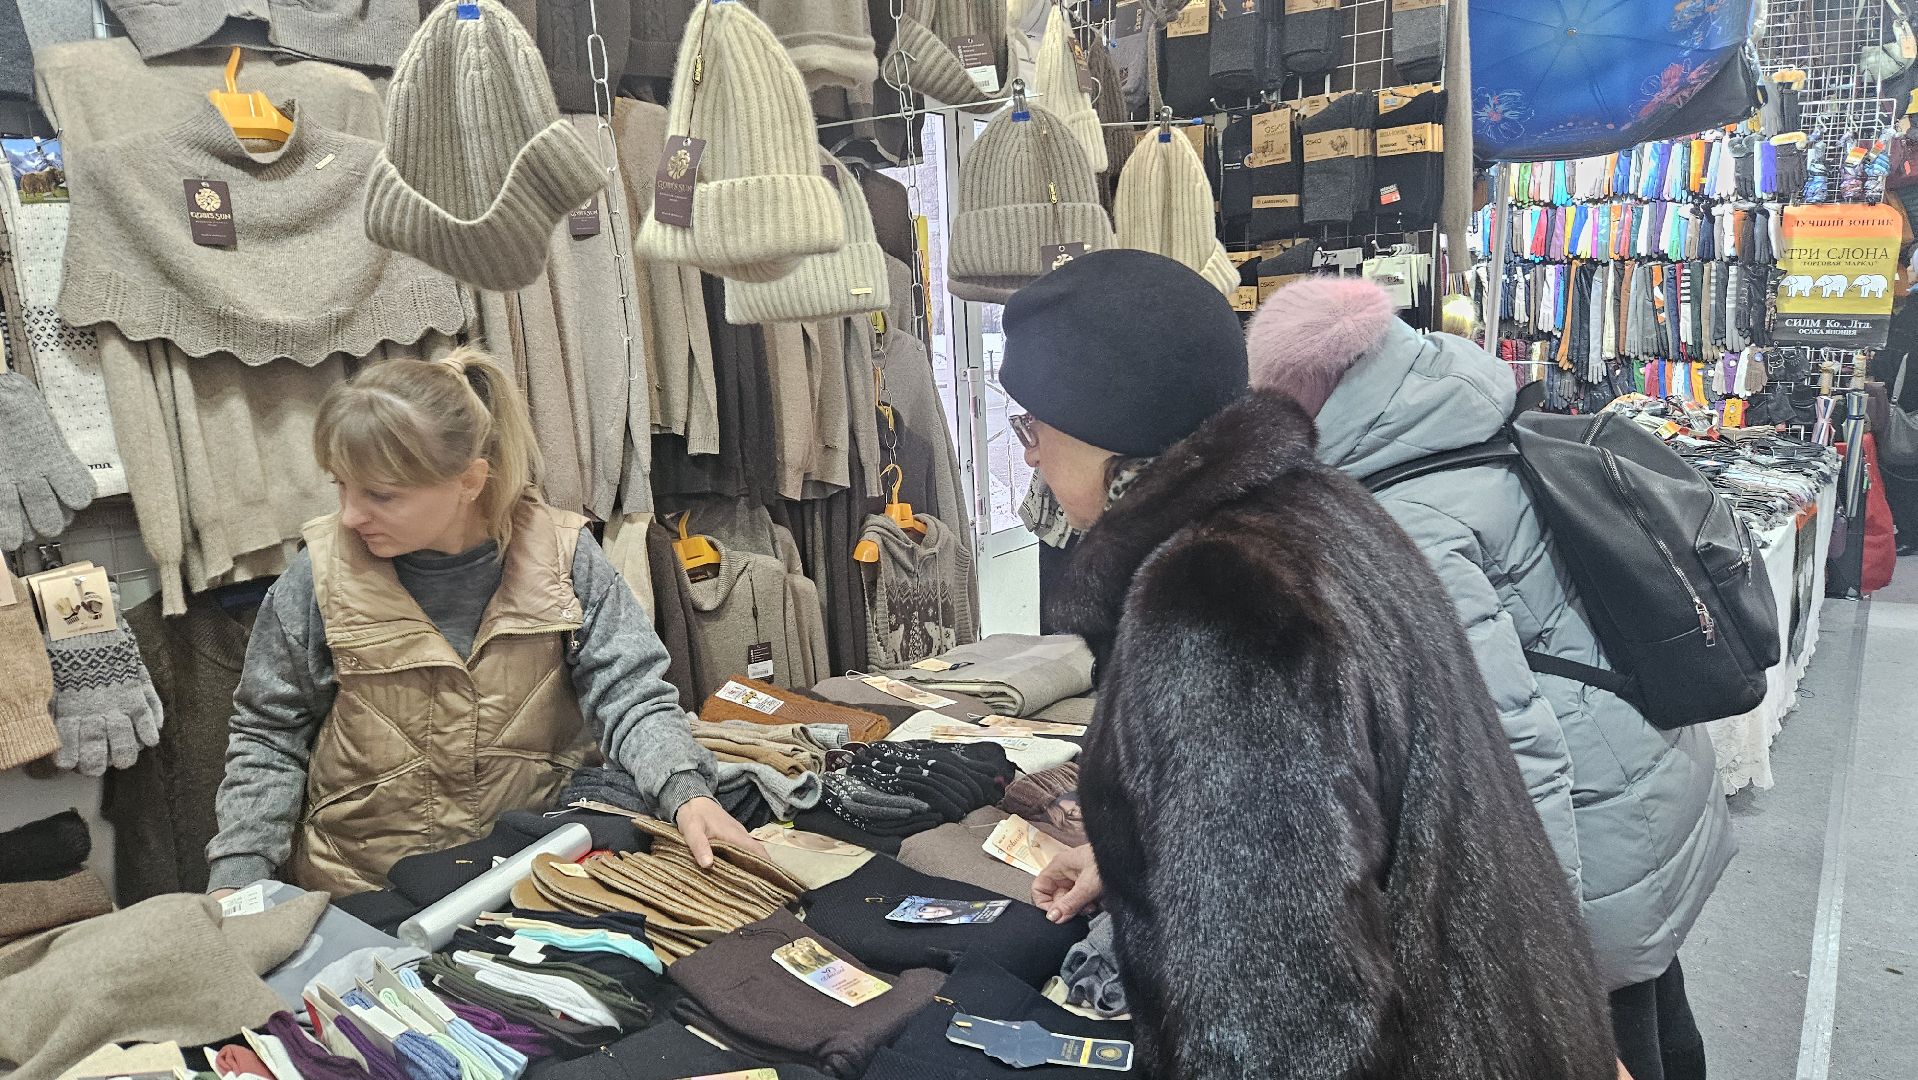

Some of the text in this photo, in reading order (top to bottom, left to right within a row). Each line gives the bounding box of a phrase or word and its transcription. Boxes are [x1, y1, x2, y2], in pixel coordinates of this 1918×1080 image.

[1792, 218, 1894, 228] ЛУЧШИЙ ЗОНТИК
[1788, 247, 1891, 260] ТРИ СЛОНА
[1784, 318, 1821, 328] СИЛМ
